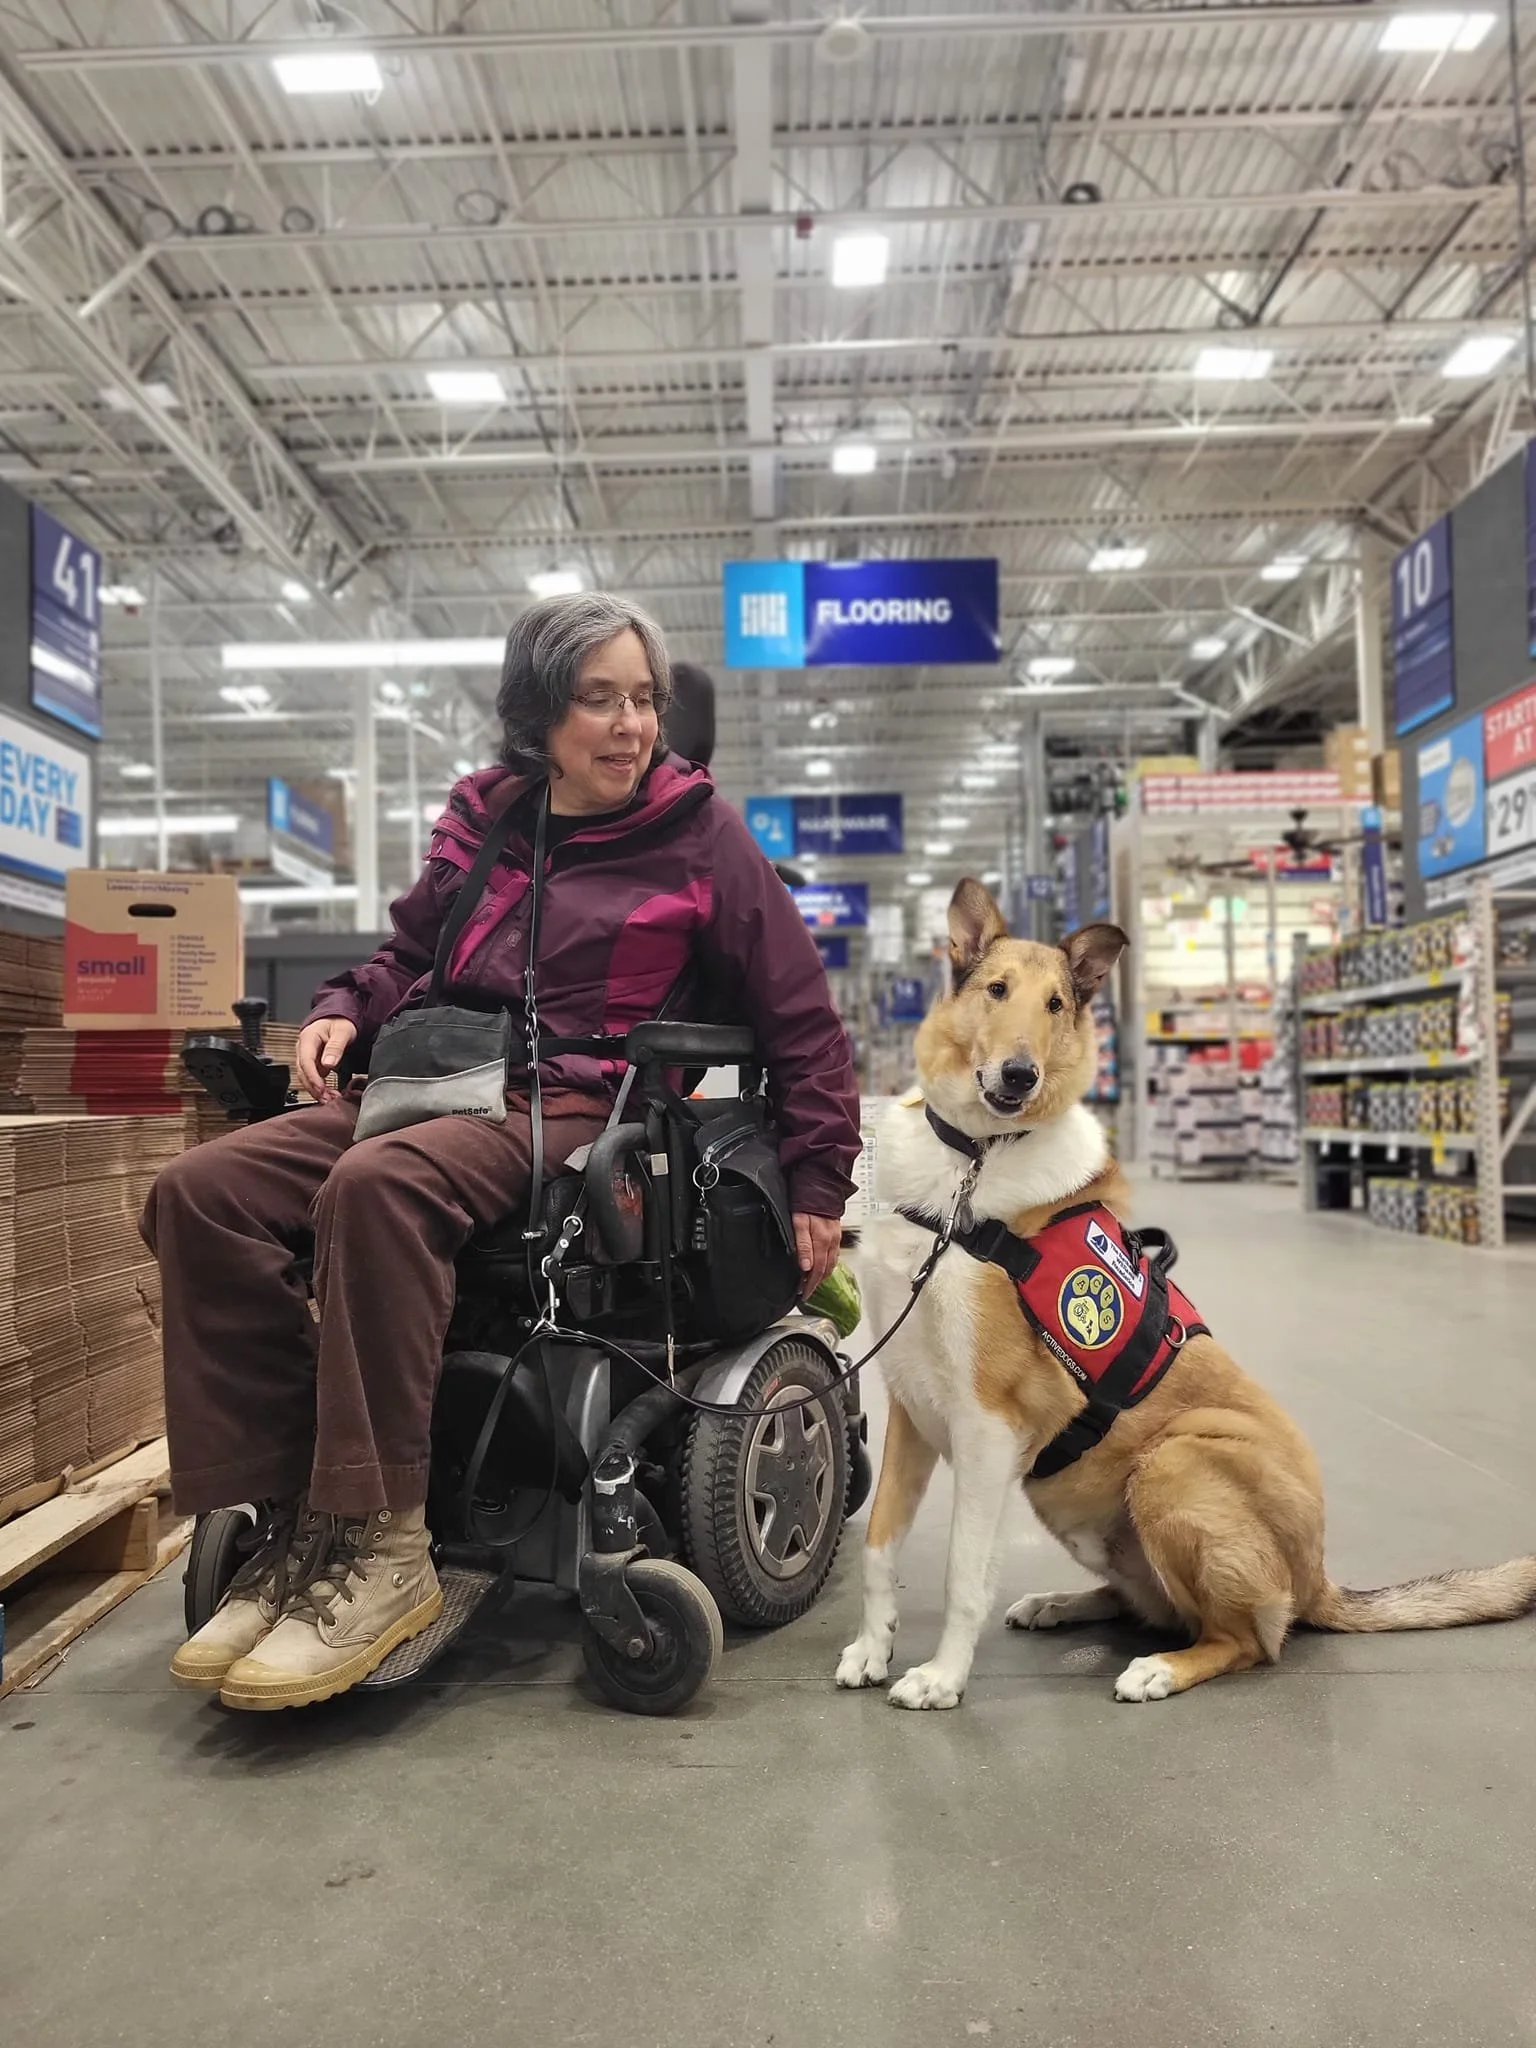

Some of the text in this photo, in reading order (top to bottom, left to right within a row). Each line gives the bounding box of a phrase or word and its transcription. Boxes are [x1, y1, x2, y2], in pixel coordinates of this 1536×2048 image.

[53, 534, 95, 621] 41
[1397, 540, 1433, 620] 10
[816, 598, 953, 625] FLOORING
[1514, 725, 1534, 757] AT
[0, 739, 78, 806] EVERY
[0, 784, 49, 837] DAY
[77, 955, 145, 976] small
[1041, 1330, 1088, 1381] ACTIVEDOGS.COM
